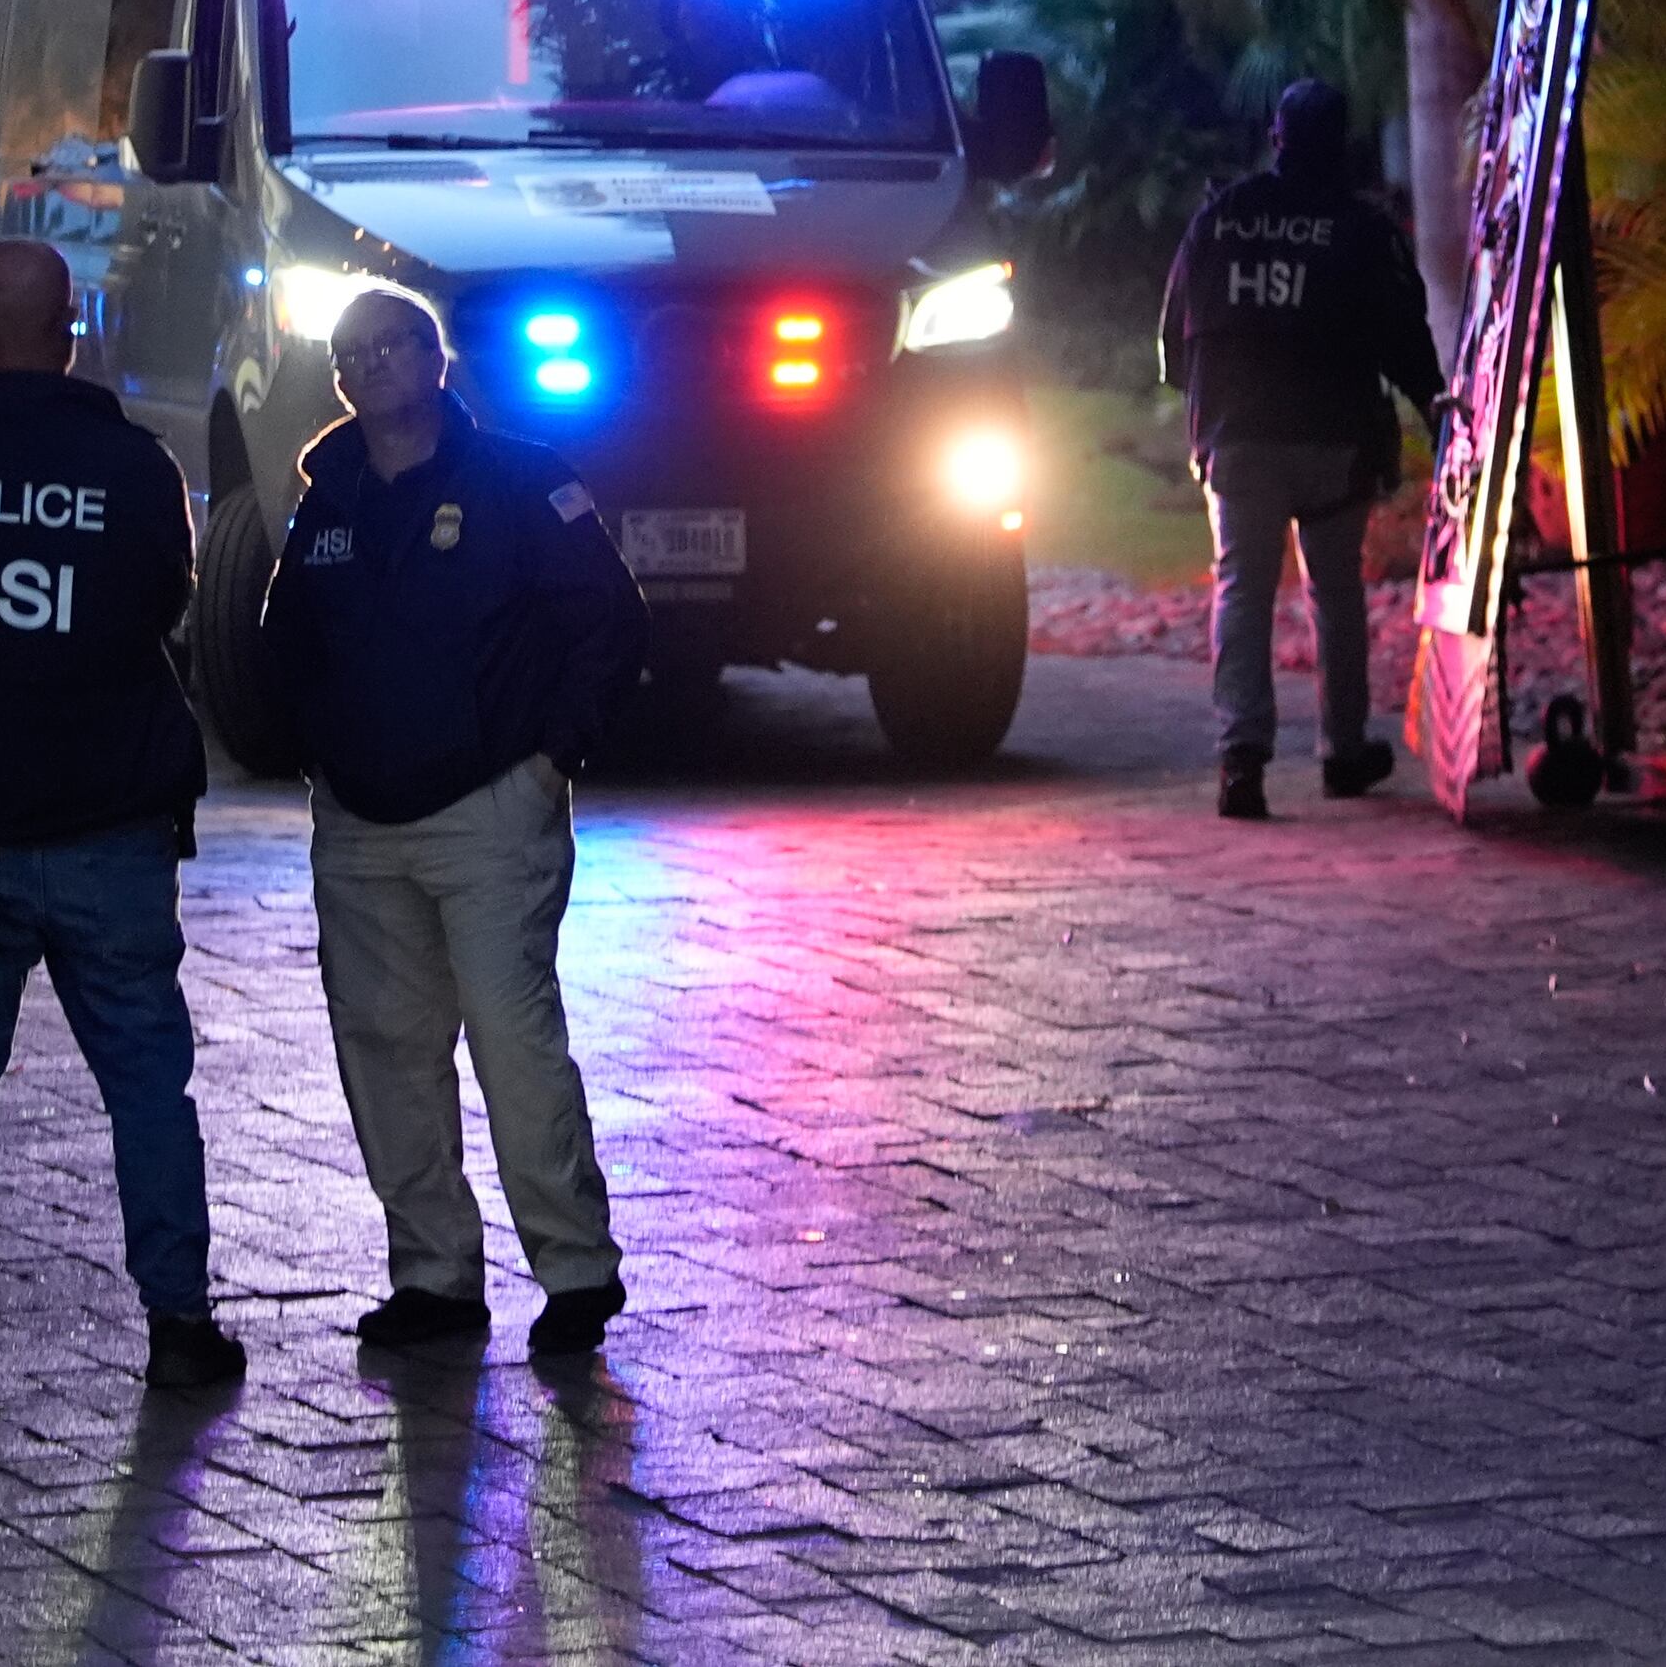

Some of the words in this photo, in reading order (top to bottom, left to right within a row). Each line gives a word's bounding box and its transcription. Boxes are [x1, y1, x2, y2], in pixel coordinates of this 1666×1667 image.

[1214, 214, 1334, 247] POLICE
[1228, 260, 1307, 308] HSI
[313, 526, 353, 558] HSI
